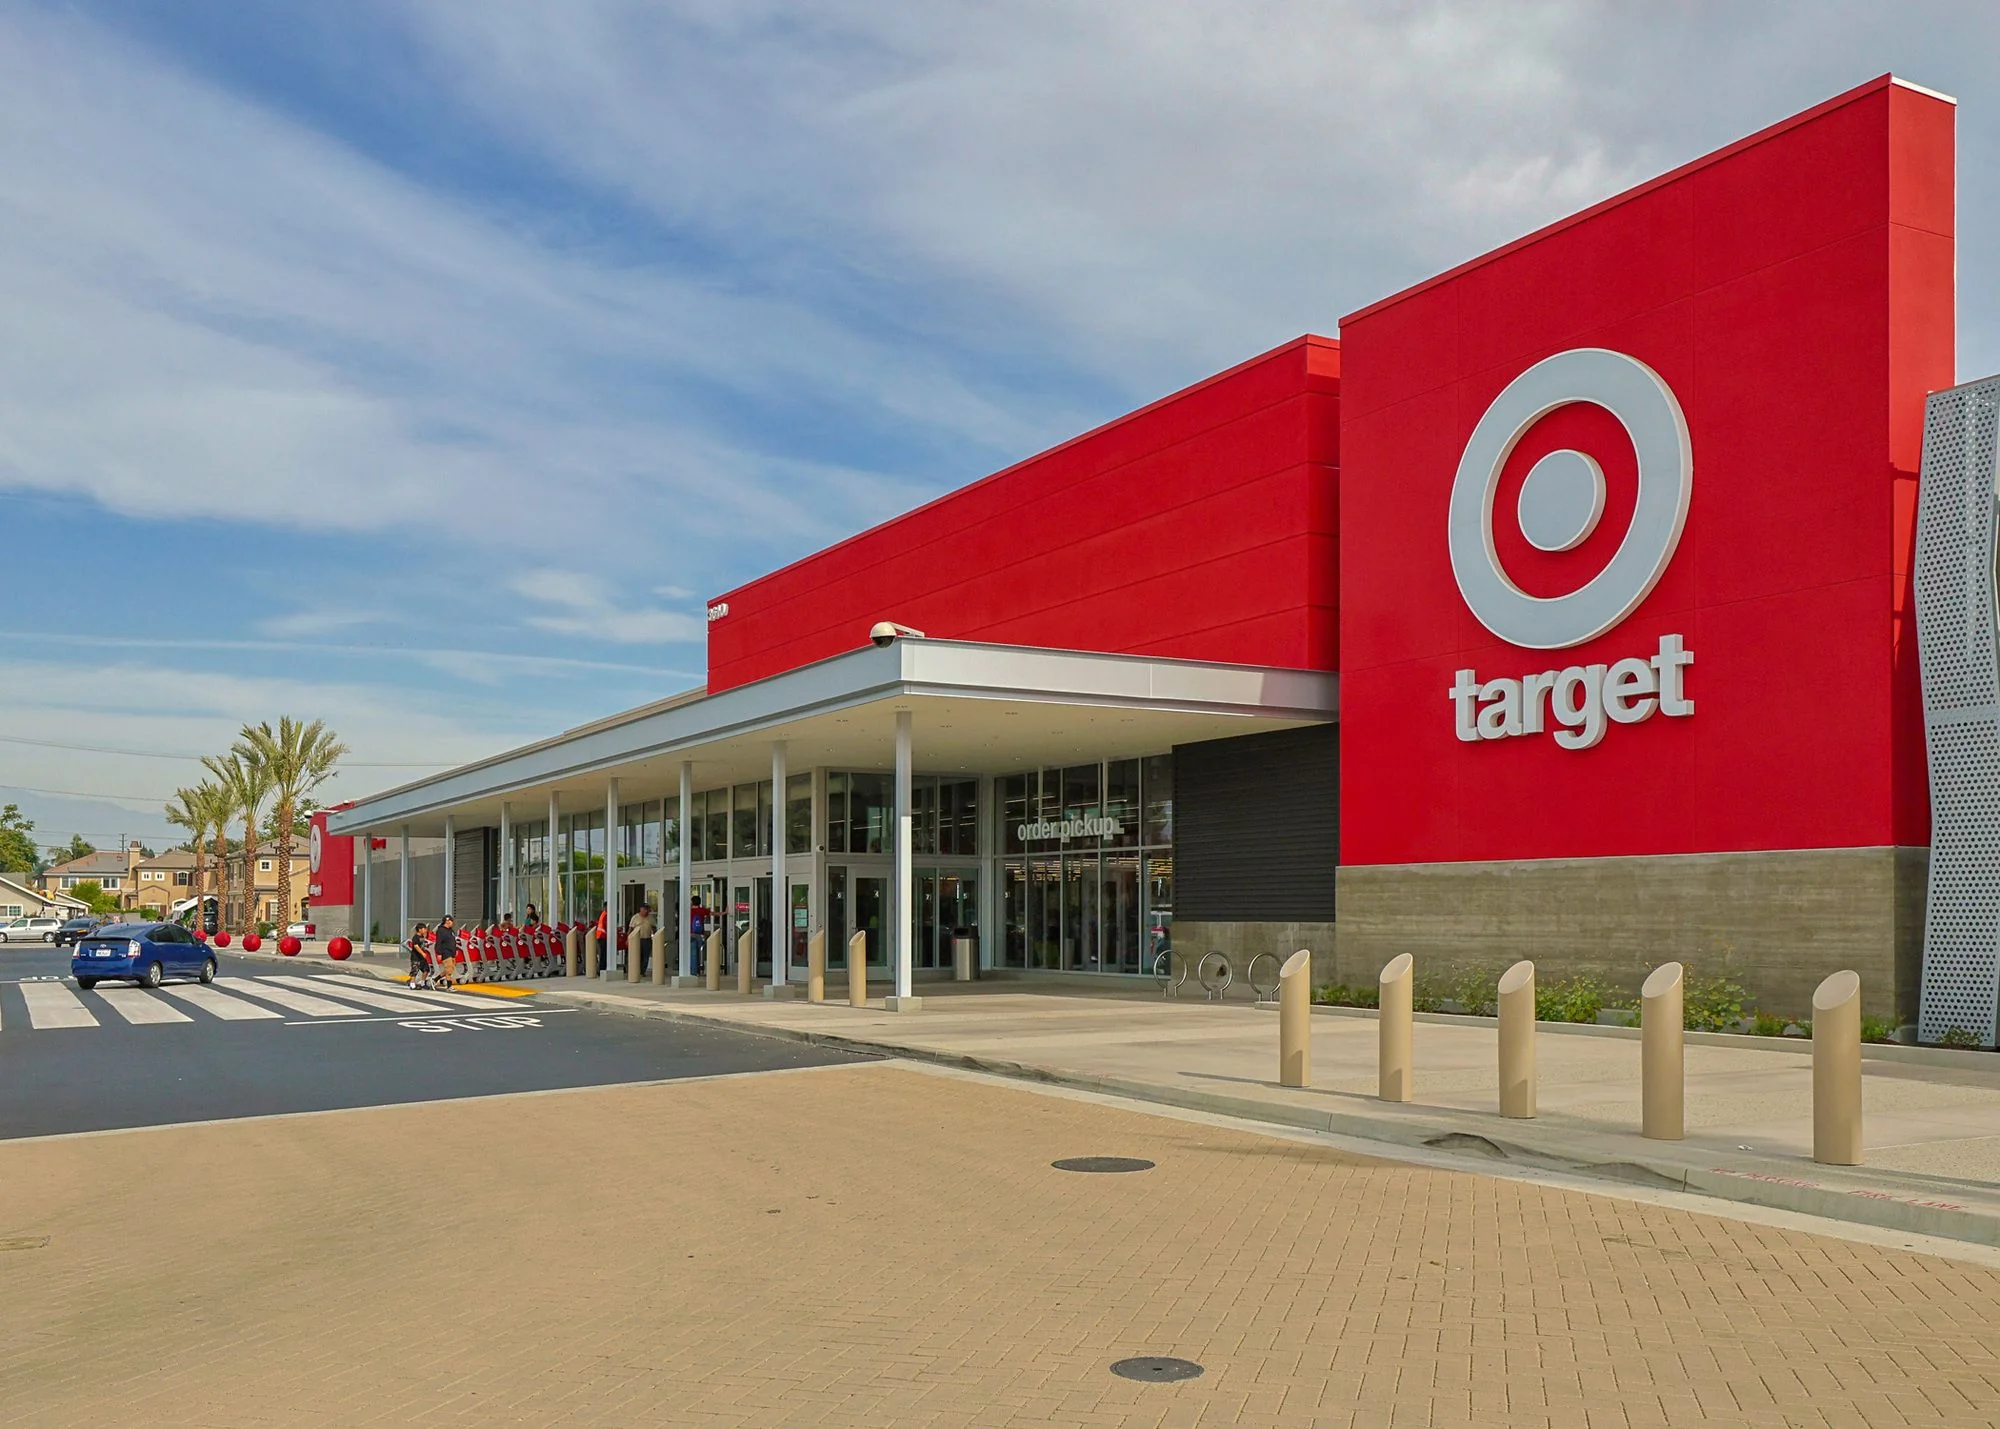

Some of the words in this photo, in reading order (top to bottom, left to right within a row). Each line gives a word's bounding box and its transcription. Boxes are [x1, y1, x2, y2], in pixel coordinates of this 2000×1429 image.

[1449, 633, 1695, 750] target
[1017, 818, 1058, 841] order
[1060, 814, 1117, 843] pickup
[396, 1016, 544, 1033] STOP
[1904, 1199, 1969, 1211] LANE
